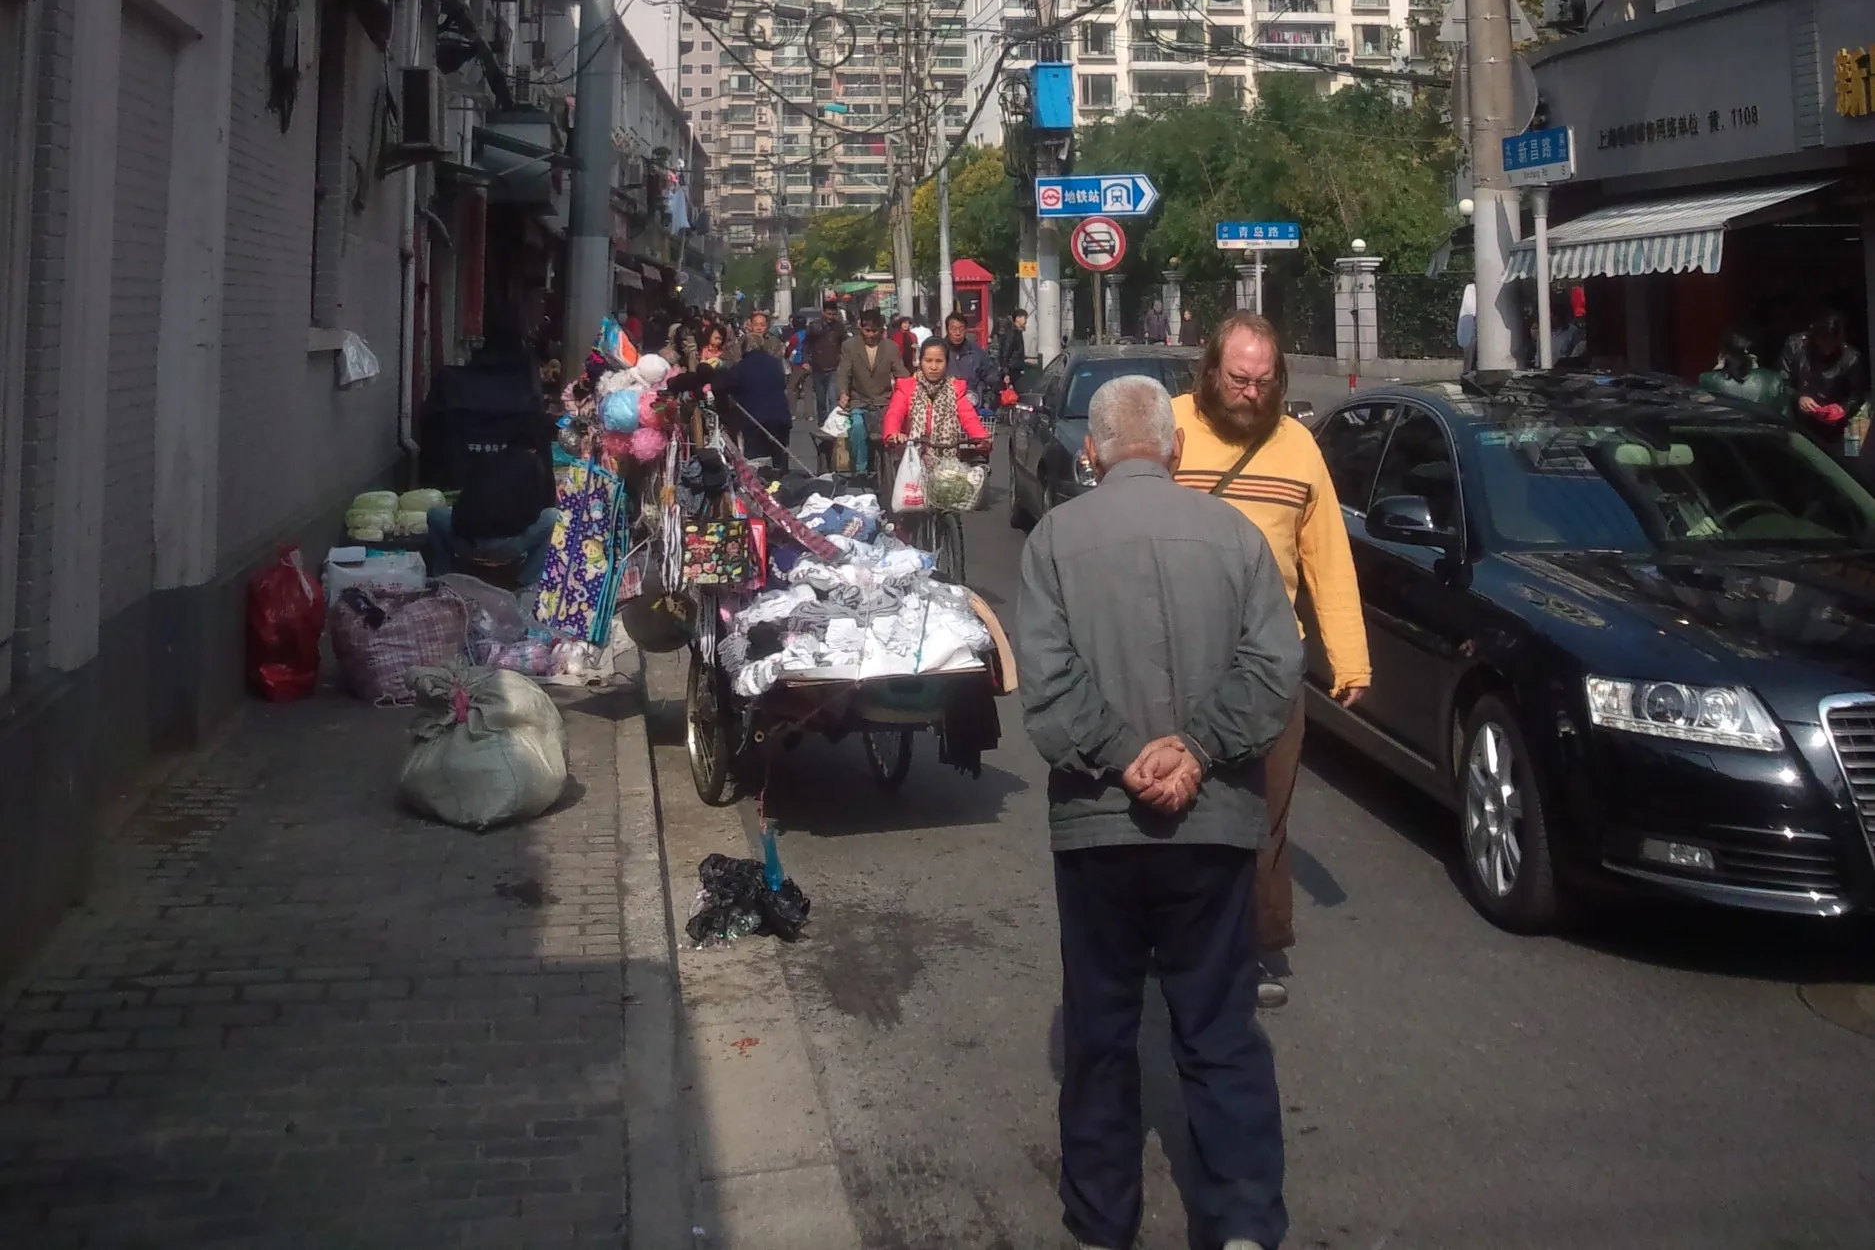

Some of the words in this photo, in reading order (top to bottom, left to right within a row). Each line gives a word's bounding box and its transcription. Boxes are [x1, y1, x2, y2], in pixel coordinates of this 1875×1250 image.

[1731, 105, 1758, 127] 1108
[1518, 137, 1552, 163] 新昌路
[1064, 189, 1100, 204] 地铁站
[1239, 226, 1279, 238] 青岛路
